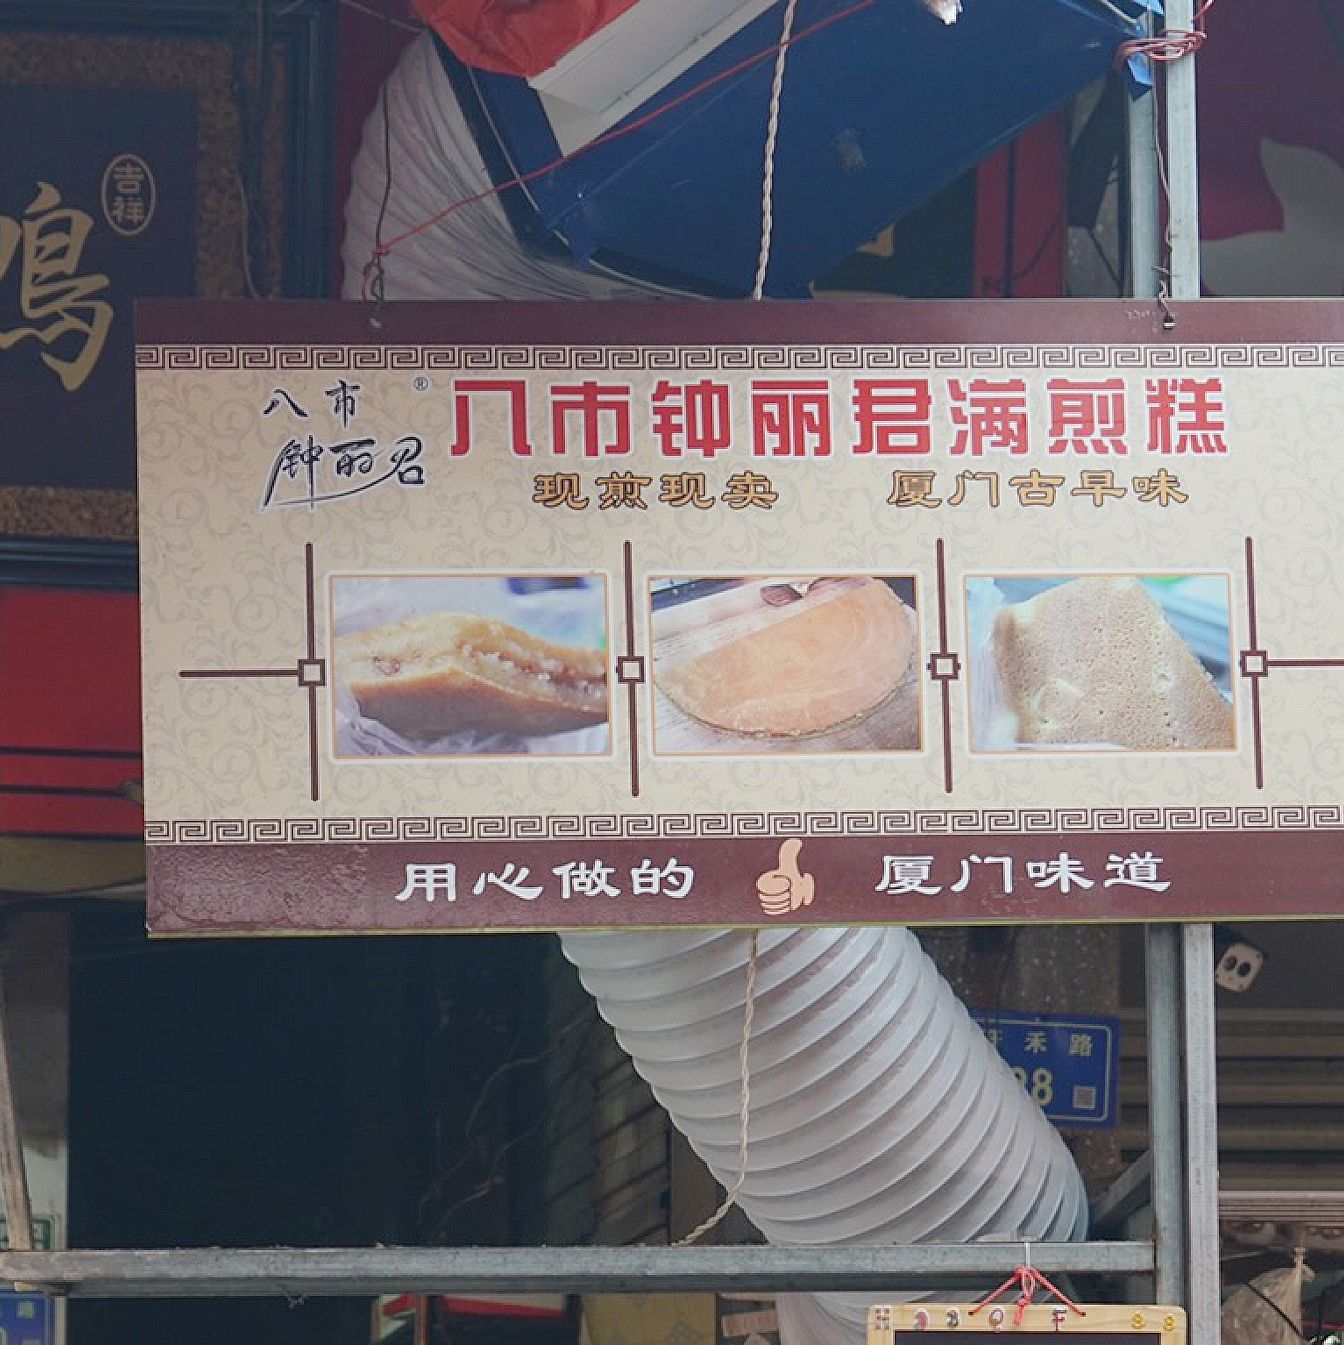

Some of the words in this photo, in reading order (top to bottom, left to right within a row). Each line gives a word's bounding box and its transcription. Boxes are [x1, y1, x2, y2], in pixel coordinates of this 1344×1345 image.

[449, 377, 1229, 458] 八市钟丽君满煎糕
[531, 471, 780, 510] 现煎现卖
[885, 469, 1188, 508] 厦门古早味
[394, 858, 695, 901] 用心做的
[873, 852, 1174, 897] 厦门味道
